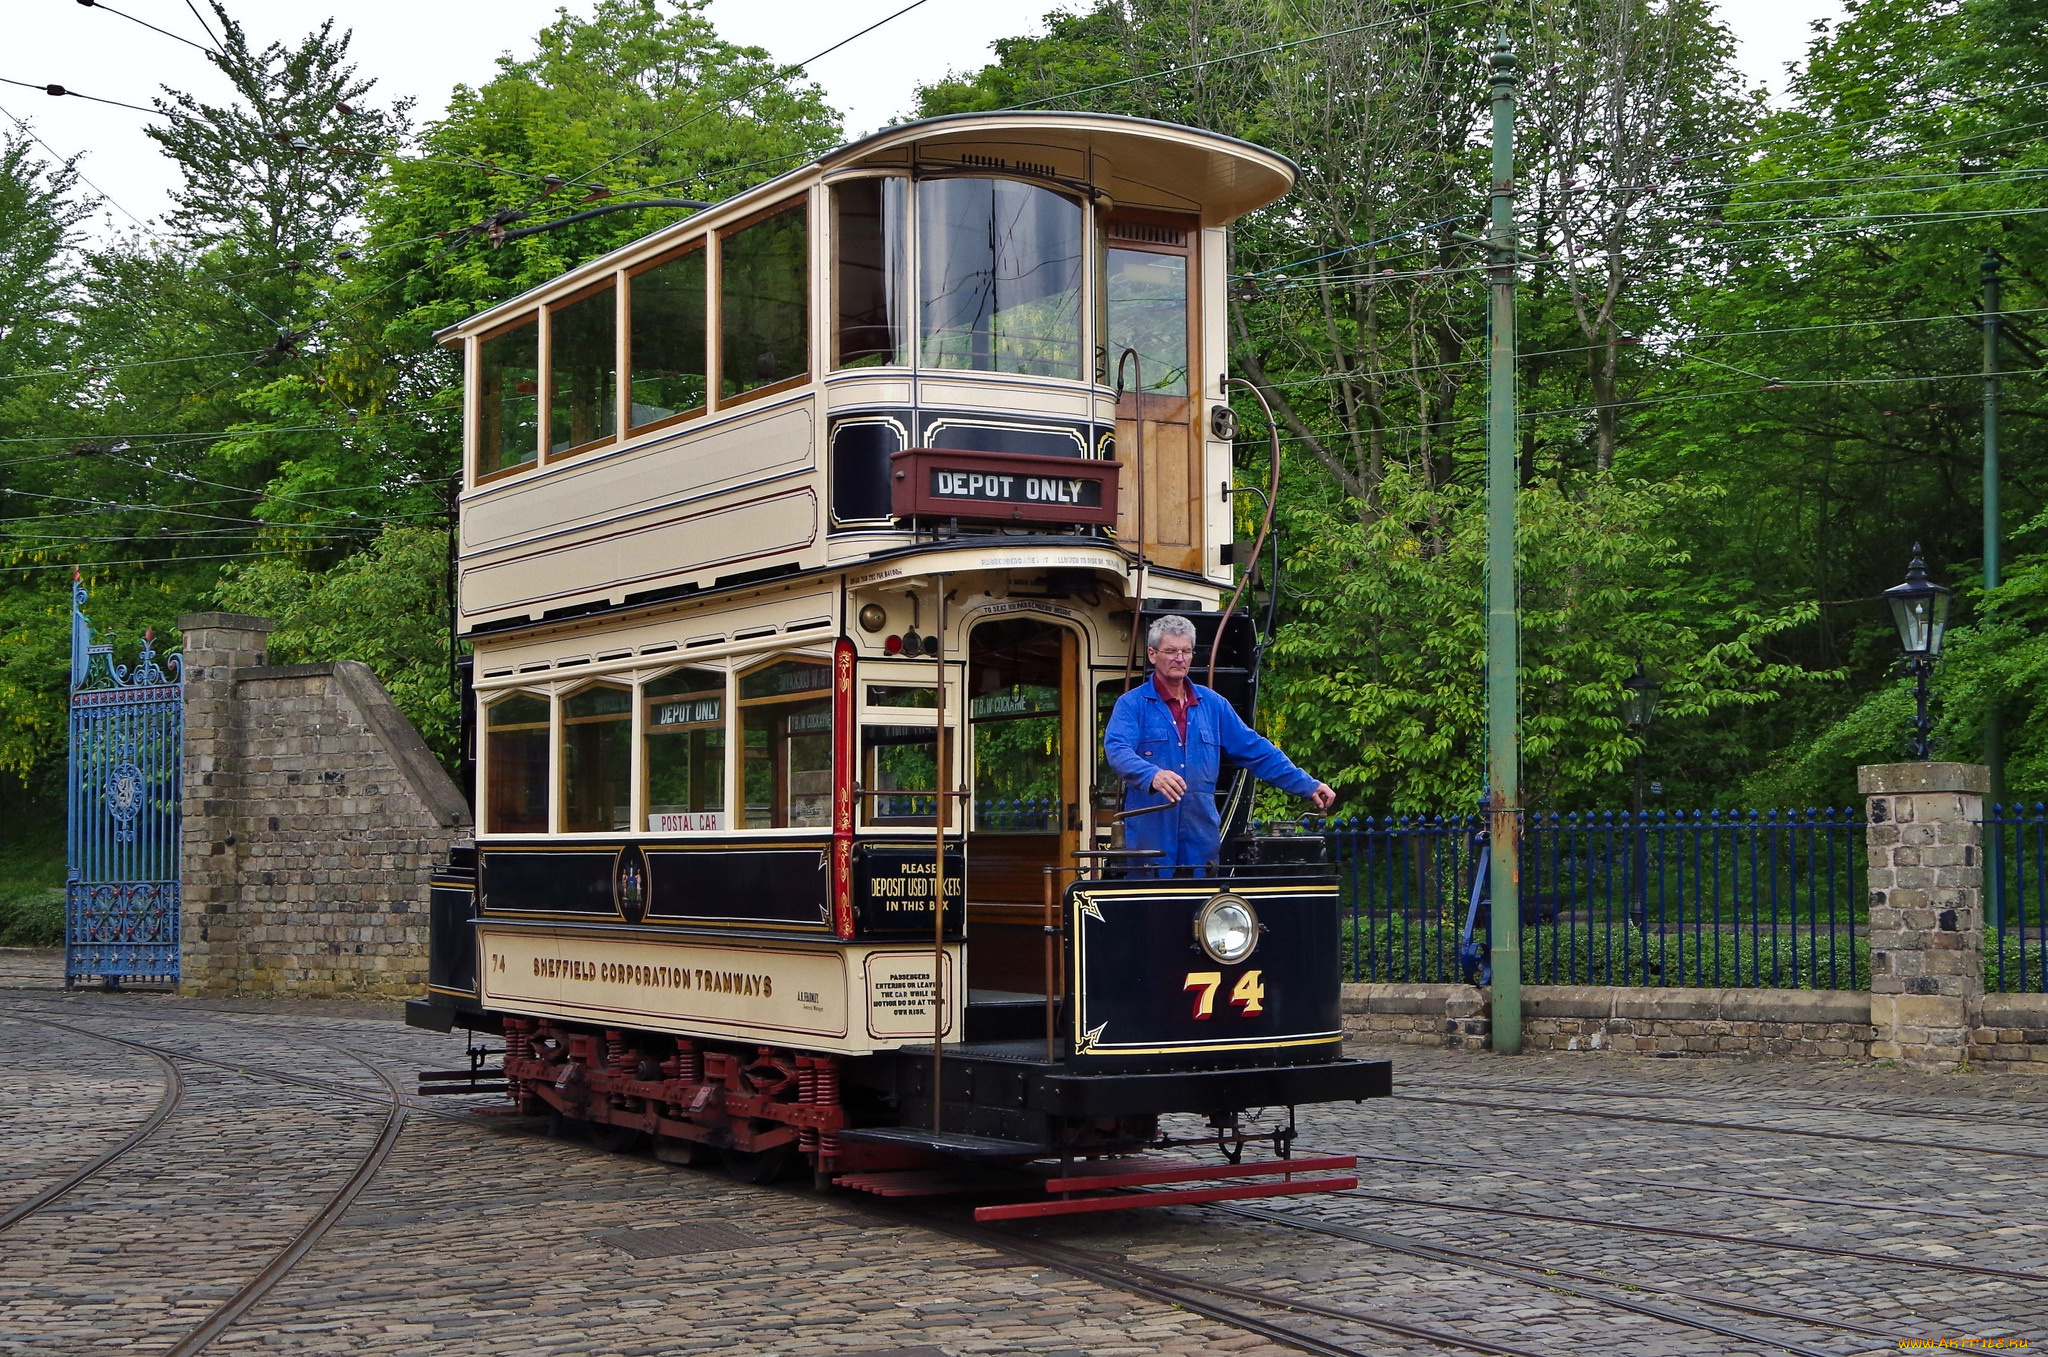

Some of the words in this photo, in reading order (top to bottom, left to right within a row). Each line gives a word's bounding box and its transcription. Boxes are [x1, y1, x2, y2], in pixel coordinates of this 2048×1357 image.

[937, 472, 1014, 498] DEPOT
[1026, 478, 1083, 503] ONLY
[993, 604, 1007, 613] SEAT
[1017, 601, 1052, 612] PASSENGERS
[660, 704, 692, 725] DEPOT
[695, 700, 720, 721] ONLY
[661, 815, 694, 832] POSTAL
[700, 814, 717, 831] CAR
[902, 863, 937, 874] PLEASE
[872, 878, 906, 897] DEPOSIT
[908, 878, 927, 896] USED
[929, 878, 961, 896] TIKETS
[886, 901, 899, 911] IN
[902, 901, 925, 911] THIS
[929, 901, 949, 911] BX
[492, 954, 506, 973] 74
[533, 957, 597, 981] SHEFFIELD
[601, 962, 691, 990] CORPORATION
[695, 969, 773, 998] TRAMWAYS
[875, 982, 906, 990] ENTERING
[873, 1000, 897, 1008] MOTION
[1183, 970, 1265, 1020] 74
